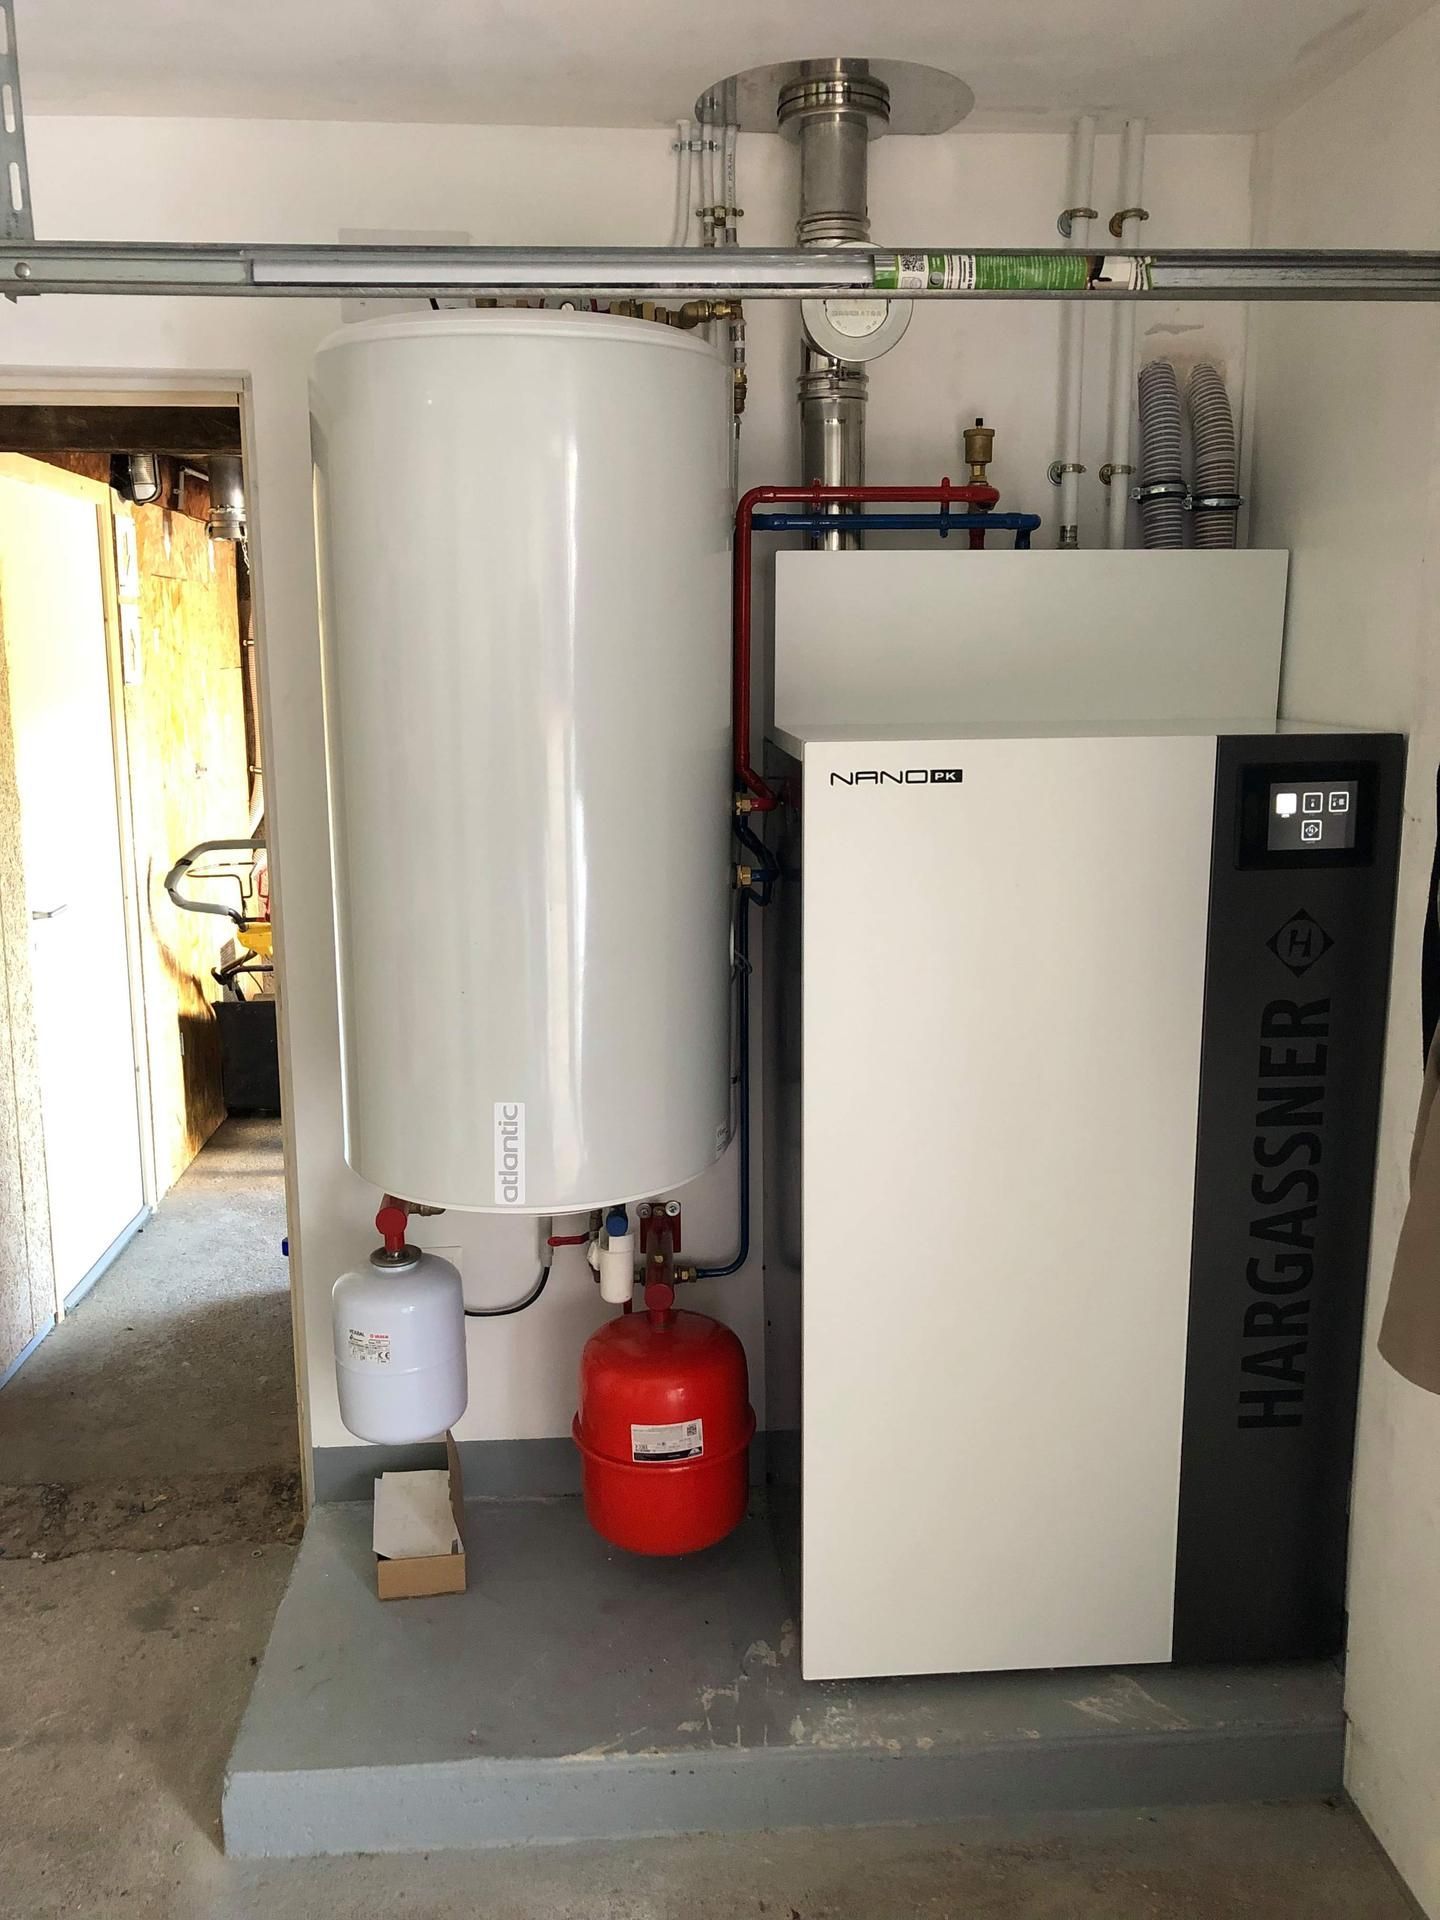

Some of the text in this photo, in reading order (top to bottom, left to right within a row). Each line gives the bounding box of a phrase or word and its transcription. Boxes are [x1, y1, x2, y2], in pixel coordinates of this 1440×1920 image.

[830, 770, 957, 786] NANO PK
[498, 1104, 519, 1203] atlantic
[1237, 997, 1331, 1429] HARGASSNER
